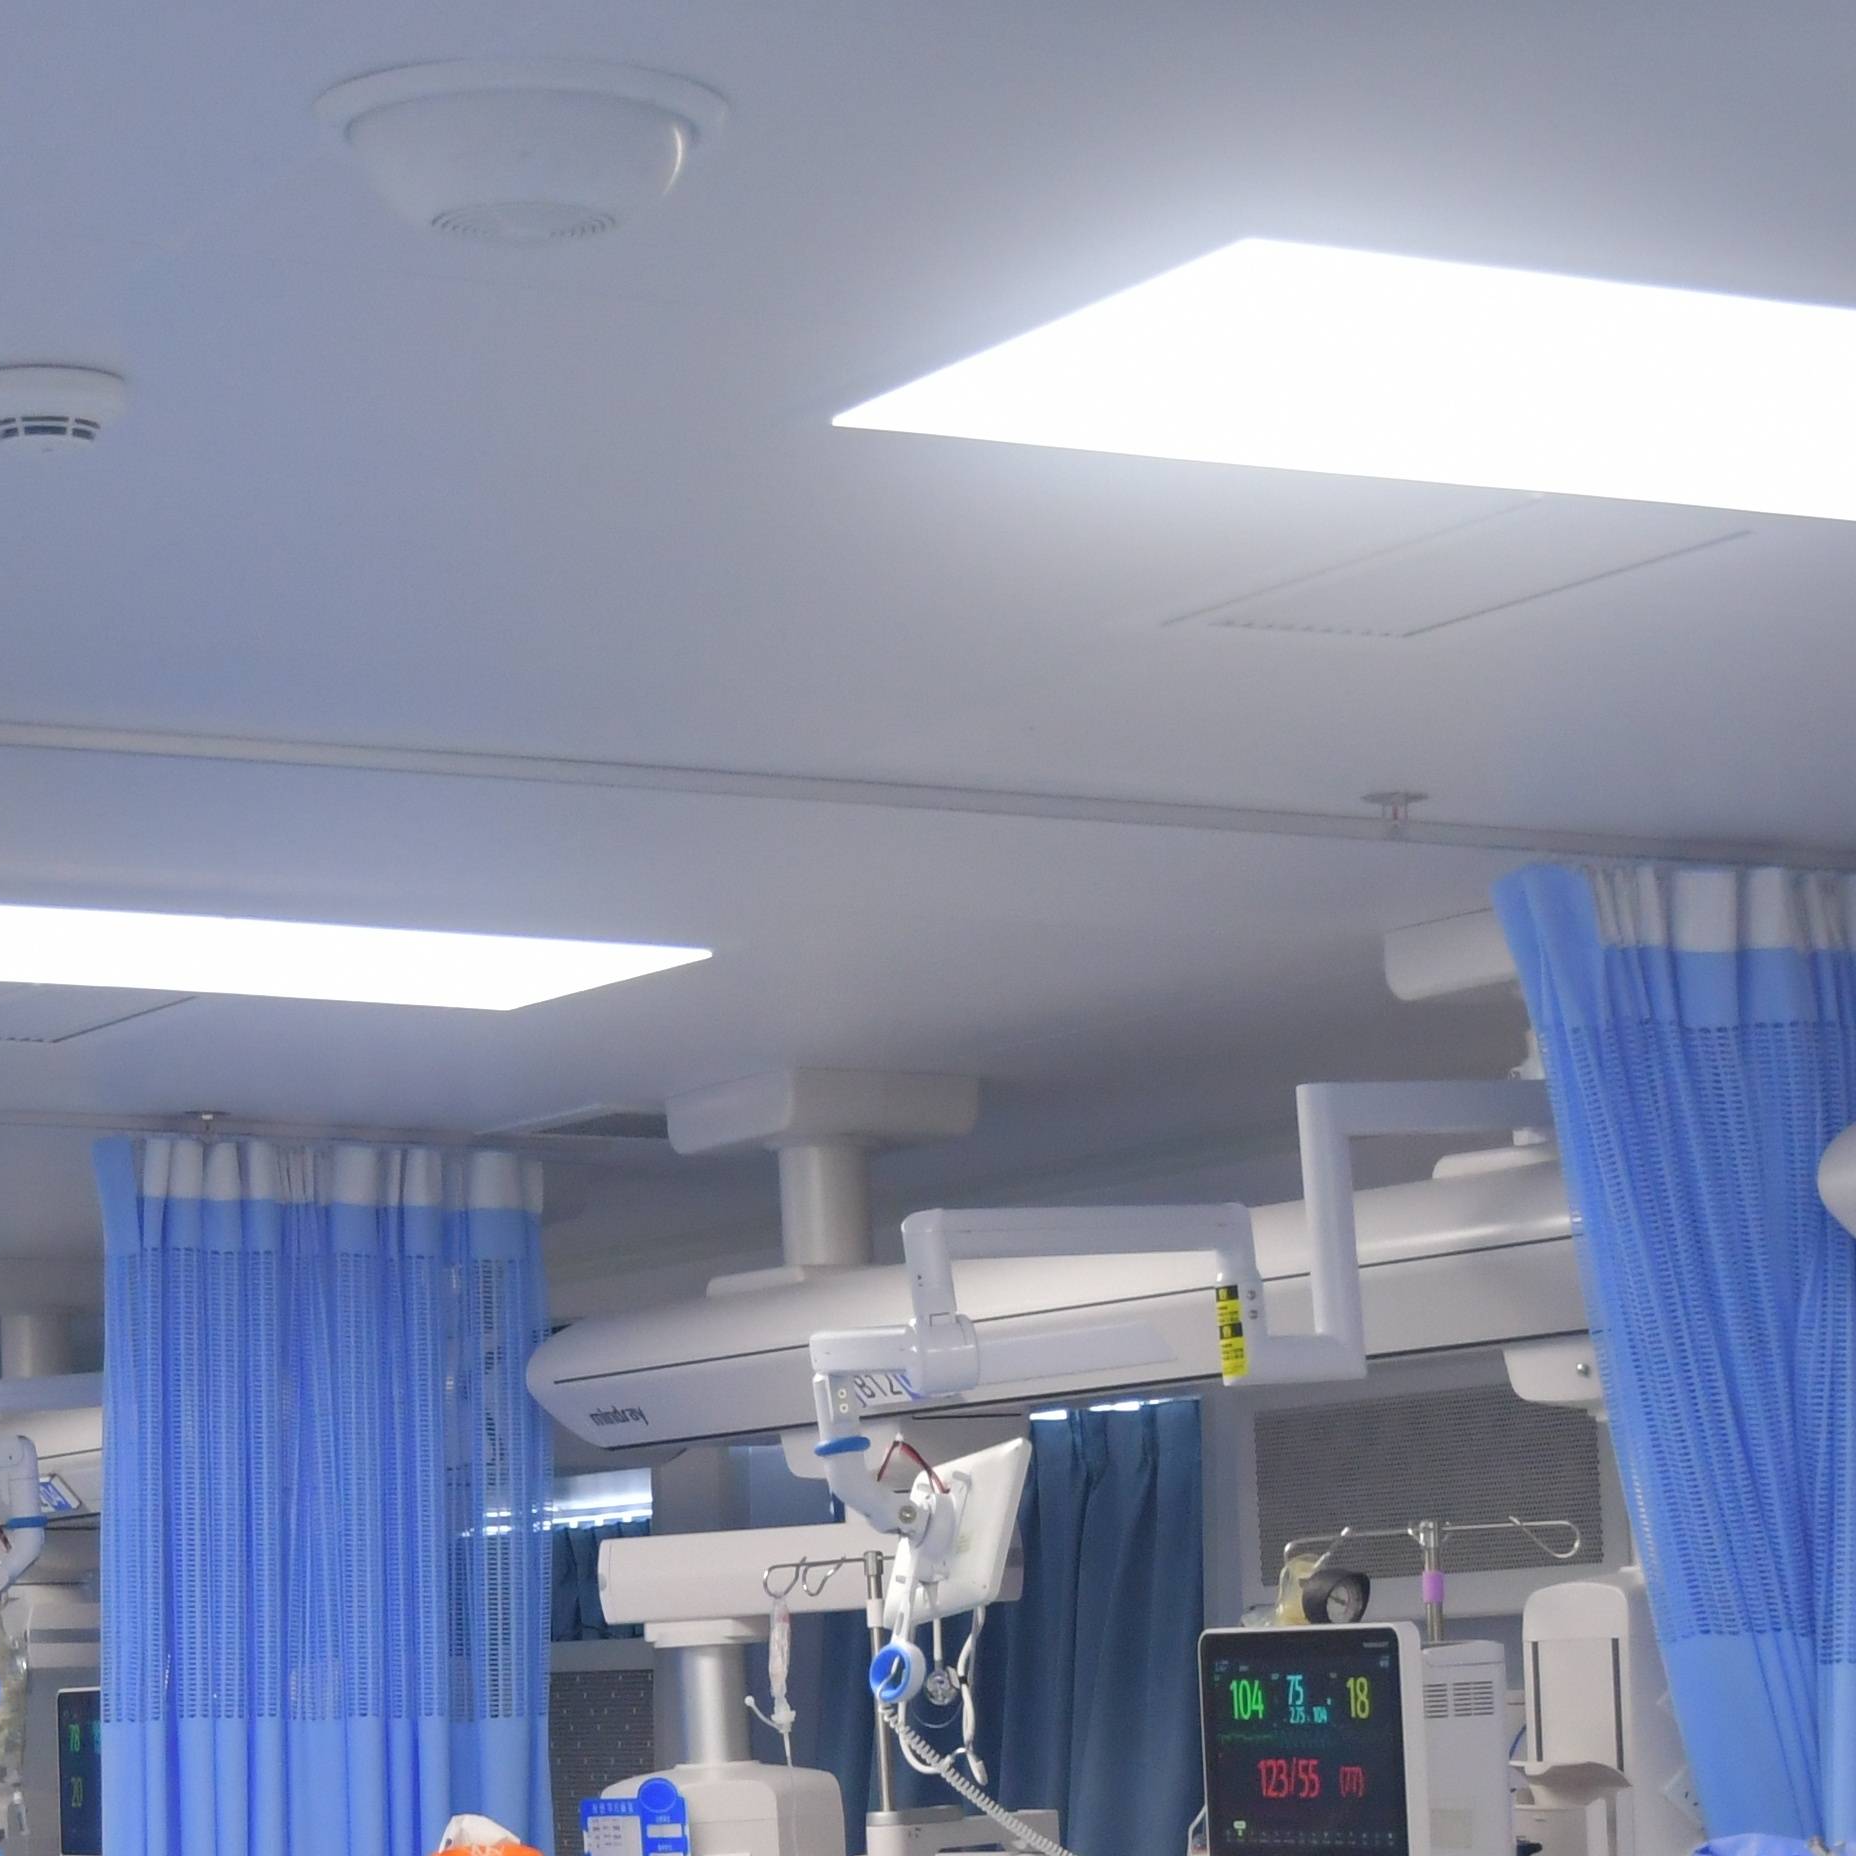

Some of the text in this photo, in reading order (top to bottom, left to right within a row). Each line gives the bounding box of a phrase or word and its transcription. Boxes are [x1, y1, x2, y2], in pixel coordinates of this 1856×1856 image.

[589, 1405, 648, 1428] mindray
[1230, 1679, 1265, 1721] 104
[1287, 1674, 1305, 1706] 75
[1346, 1676, 1371, 1719] 18
[1258, 1757, 1321, 1798] 123/55
